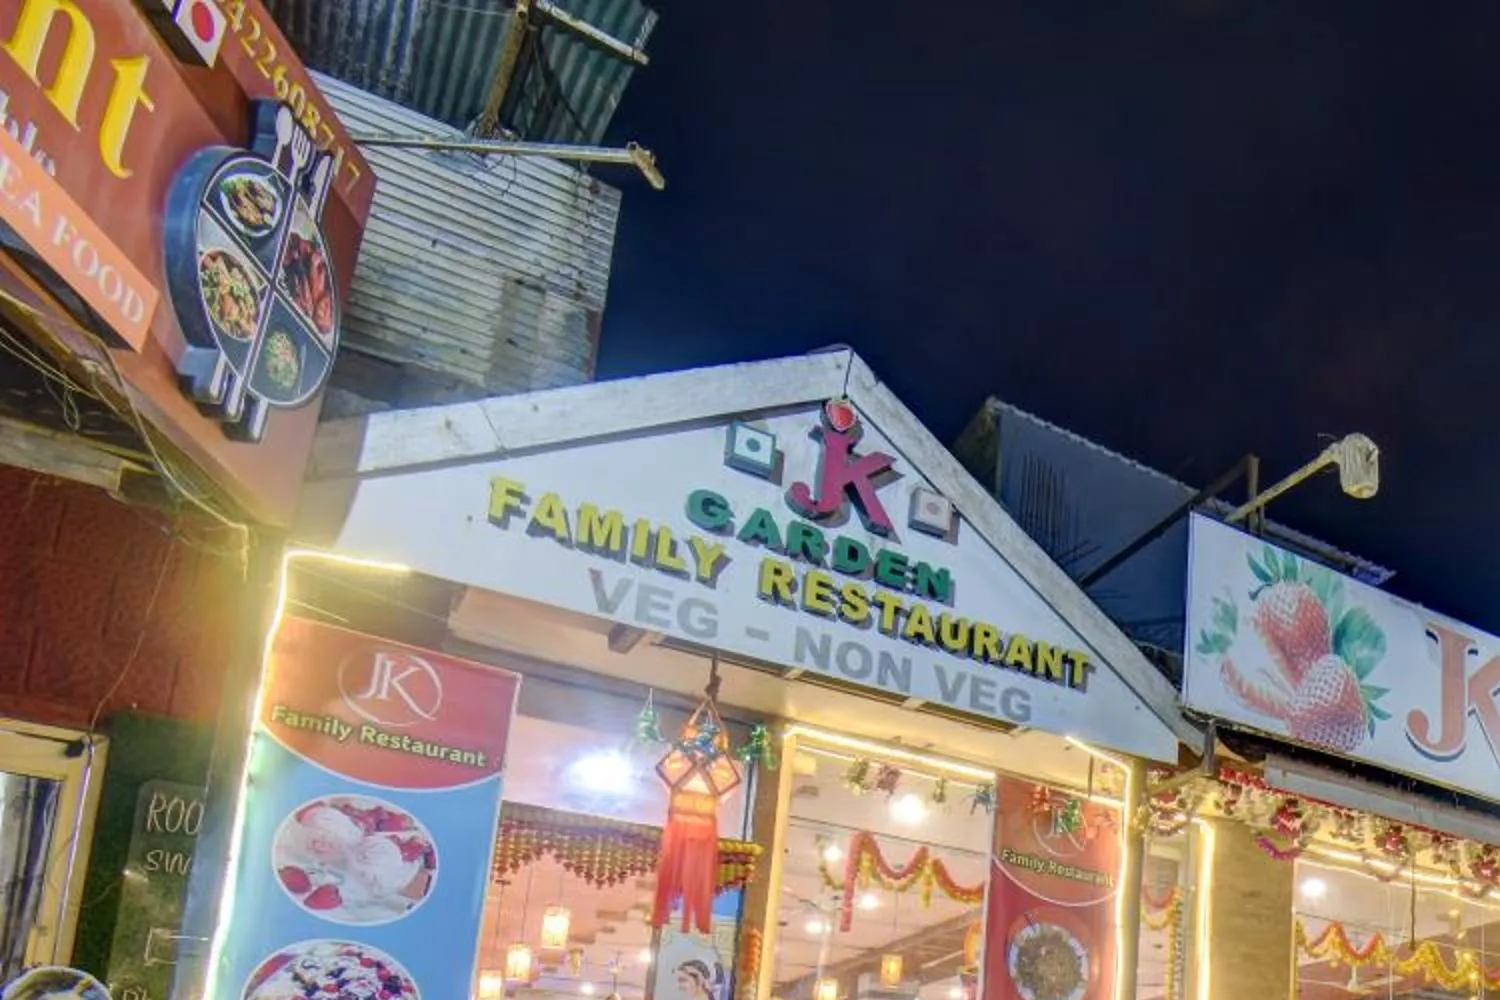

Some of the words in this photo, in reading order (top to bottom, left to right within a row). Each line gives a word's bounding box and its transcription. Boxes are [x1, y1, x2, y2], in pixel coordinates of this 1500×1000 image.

[0, 0, 154, 179] nt
[54, 215, 145, 325] FOOD
[785, 402, 899, 537] JK
[488, 476, 729, 580] FAMILY
[760, 558, 1092, 690] RESTAURANT
[686, 489, 953, 601] GARDEN
[358, 651, 437, 720] JK
[589, 569, 719, 640] VEG
[795, 625, 913, 692] NON
[934, 664, 1033, 723] VEG
[271, 704, 352, 740] Family
[360, 723, 487, 767] Restaurant
[1002, 848, 1045, 873] Family
